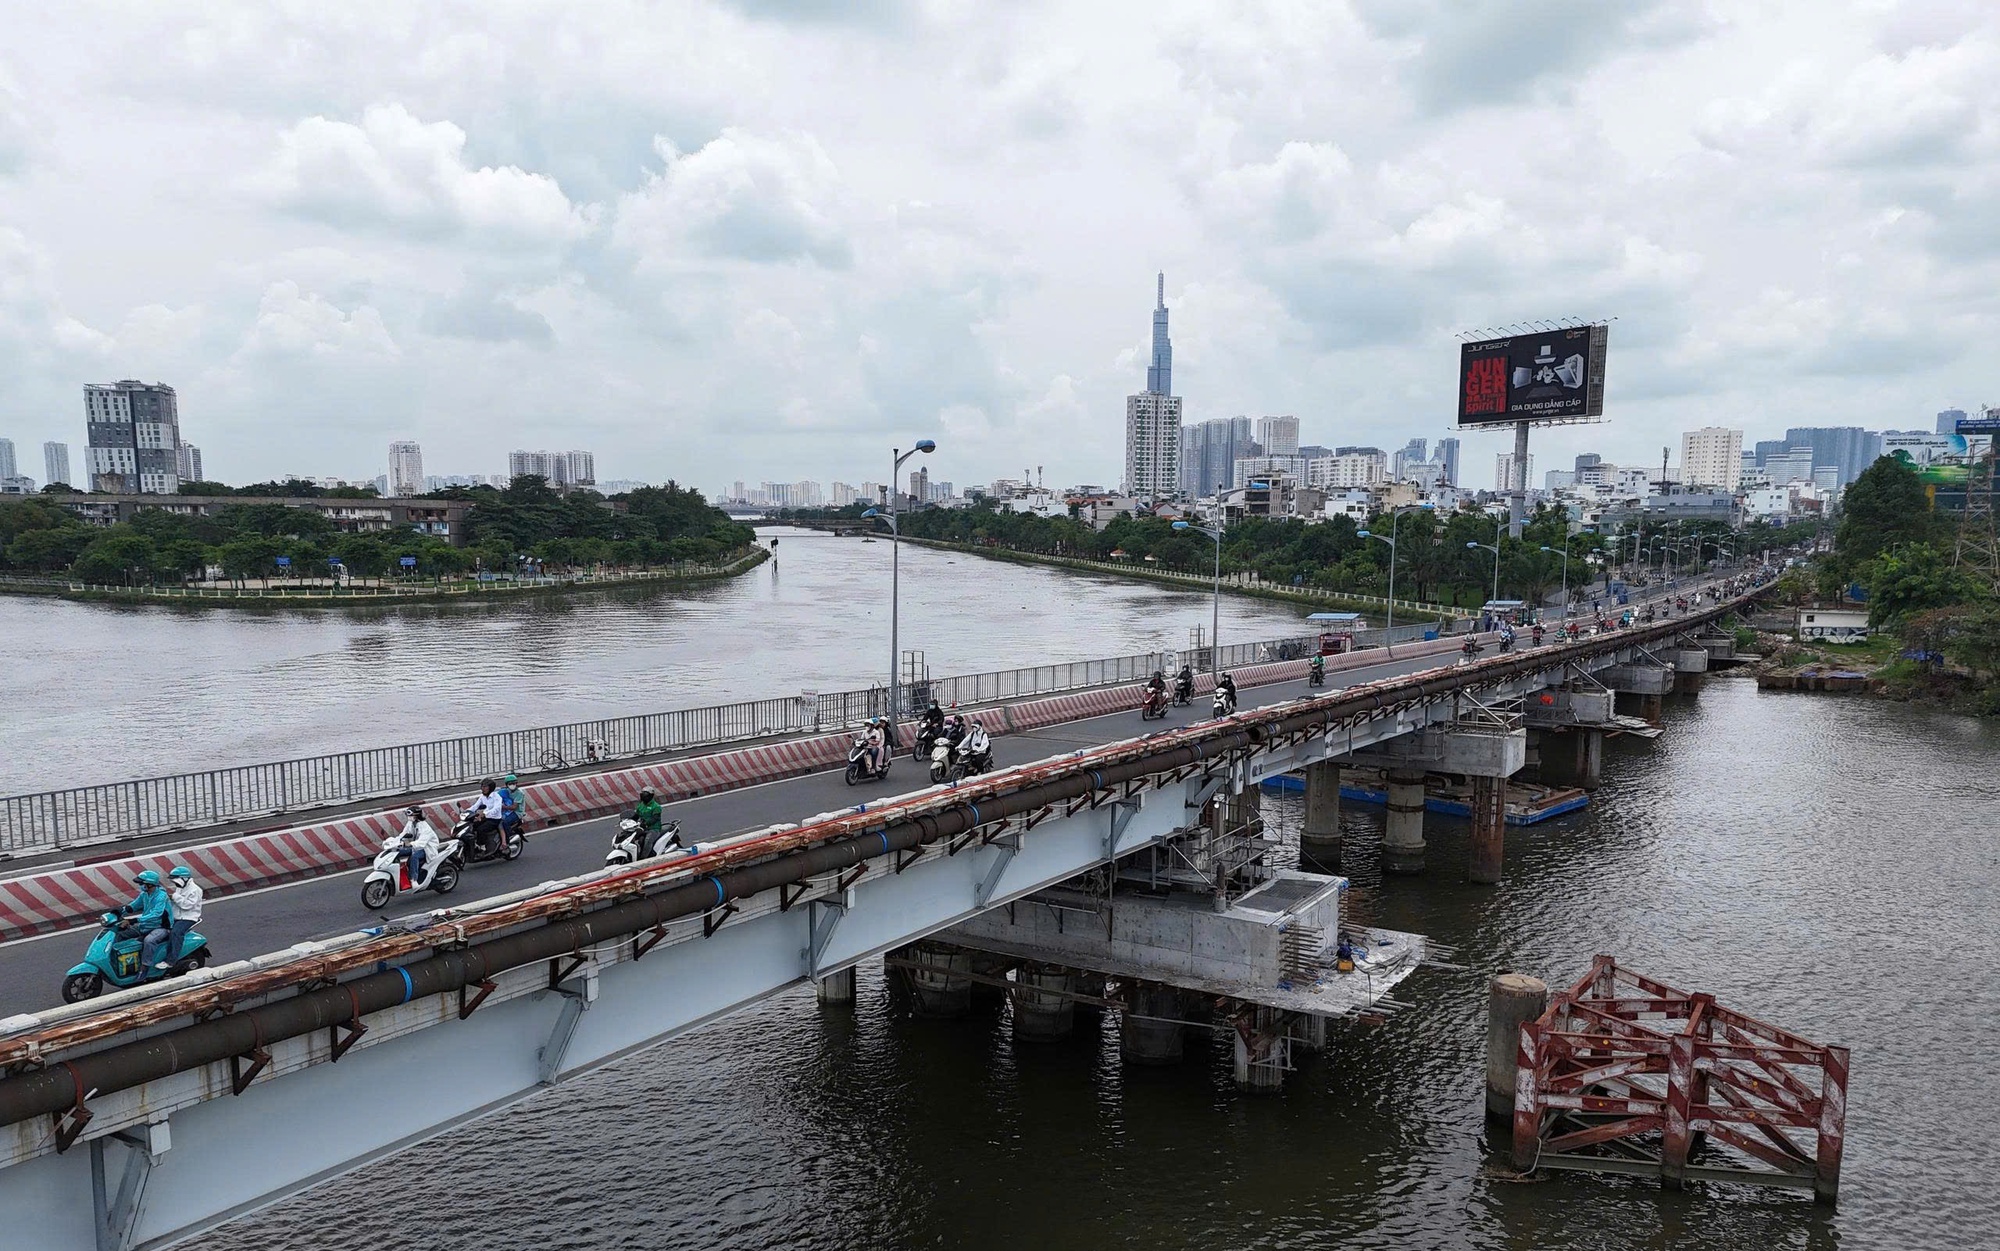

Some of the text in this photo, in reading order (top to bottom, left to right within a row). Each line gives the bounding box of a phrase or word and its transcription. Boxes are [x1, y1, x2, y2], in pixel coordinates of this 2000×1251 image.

[1467, 357, 1506, 378] JUN
[1466, 375, 1506, 396] GER
[1511, 404, 1523, 412] GIA
[1565, 397, 1581, 407] CẤP
